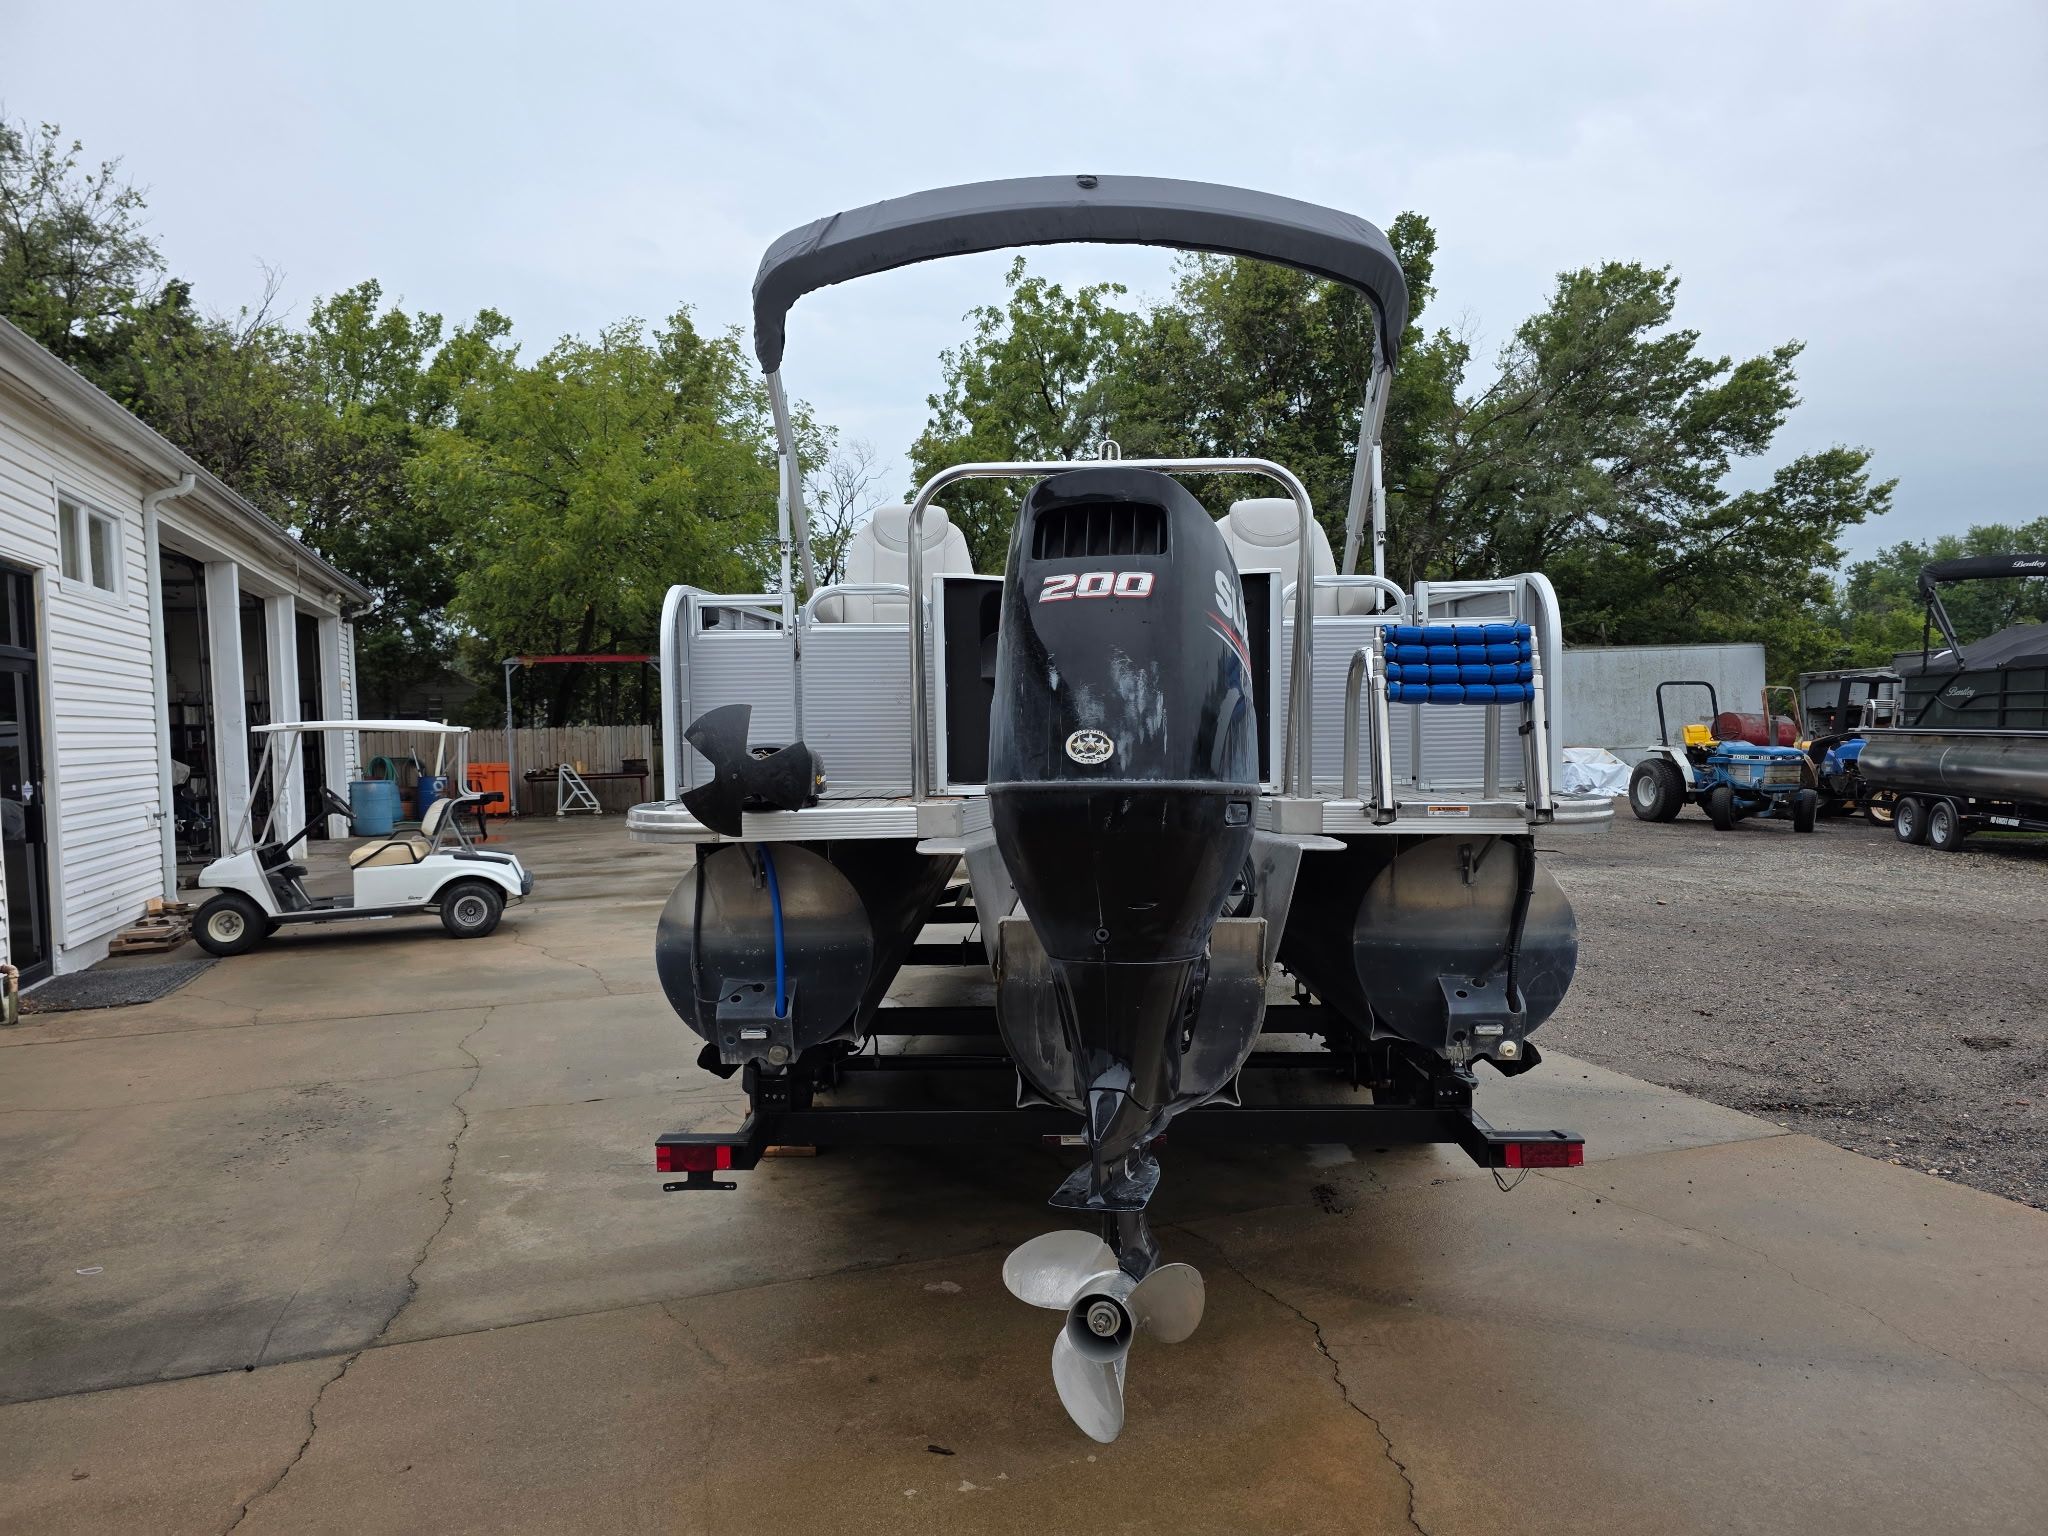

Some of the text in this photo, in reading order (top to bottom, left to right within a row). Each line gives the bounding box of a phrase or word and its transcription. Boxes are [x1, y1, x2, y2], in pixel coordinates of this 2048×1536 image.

[2011, 560, 2047, 568] Bentley
[1039, 571, 1155, 603] 200
[1946, 686, 1976, 698] Bentley
